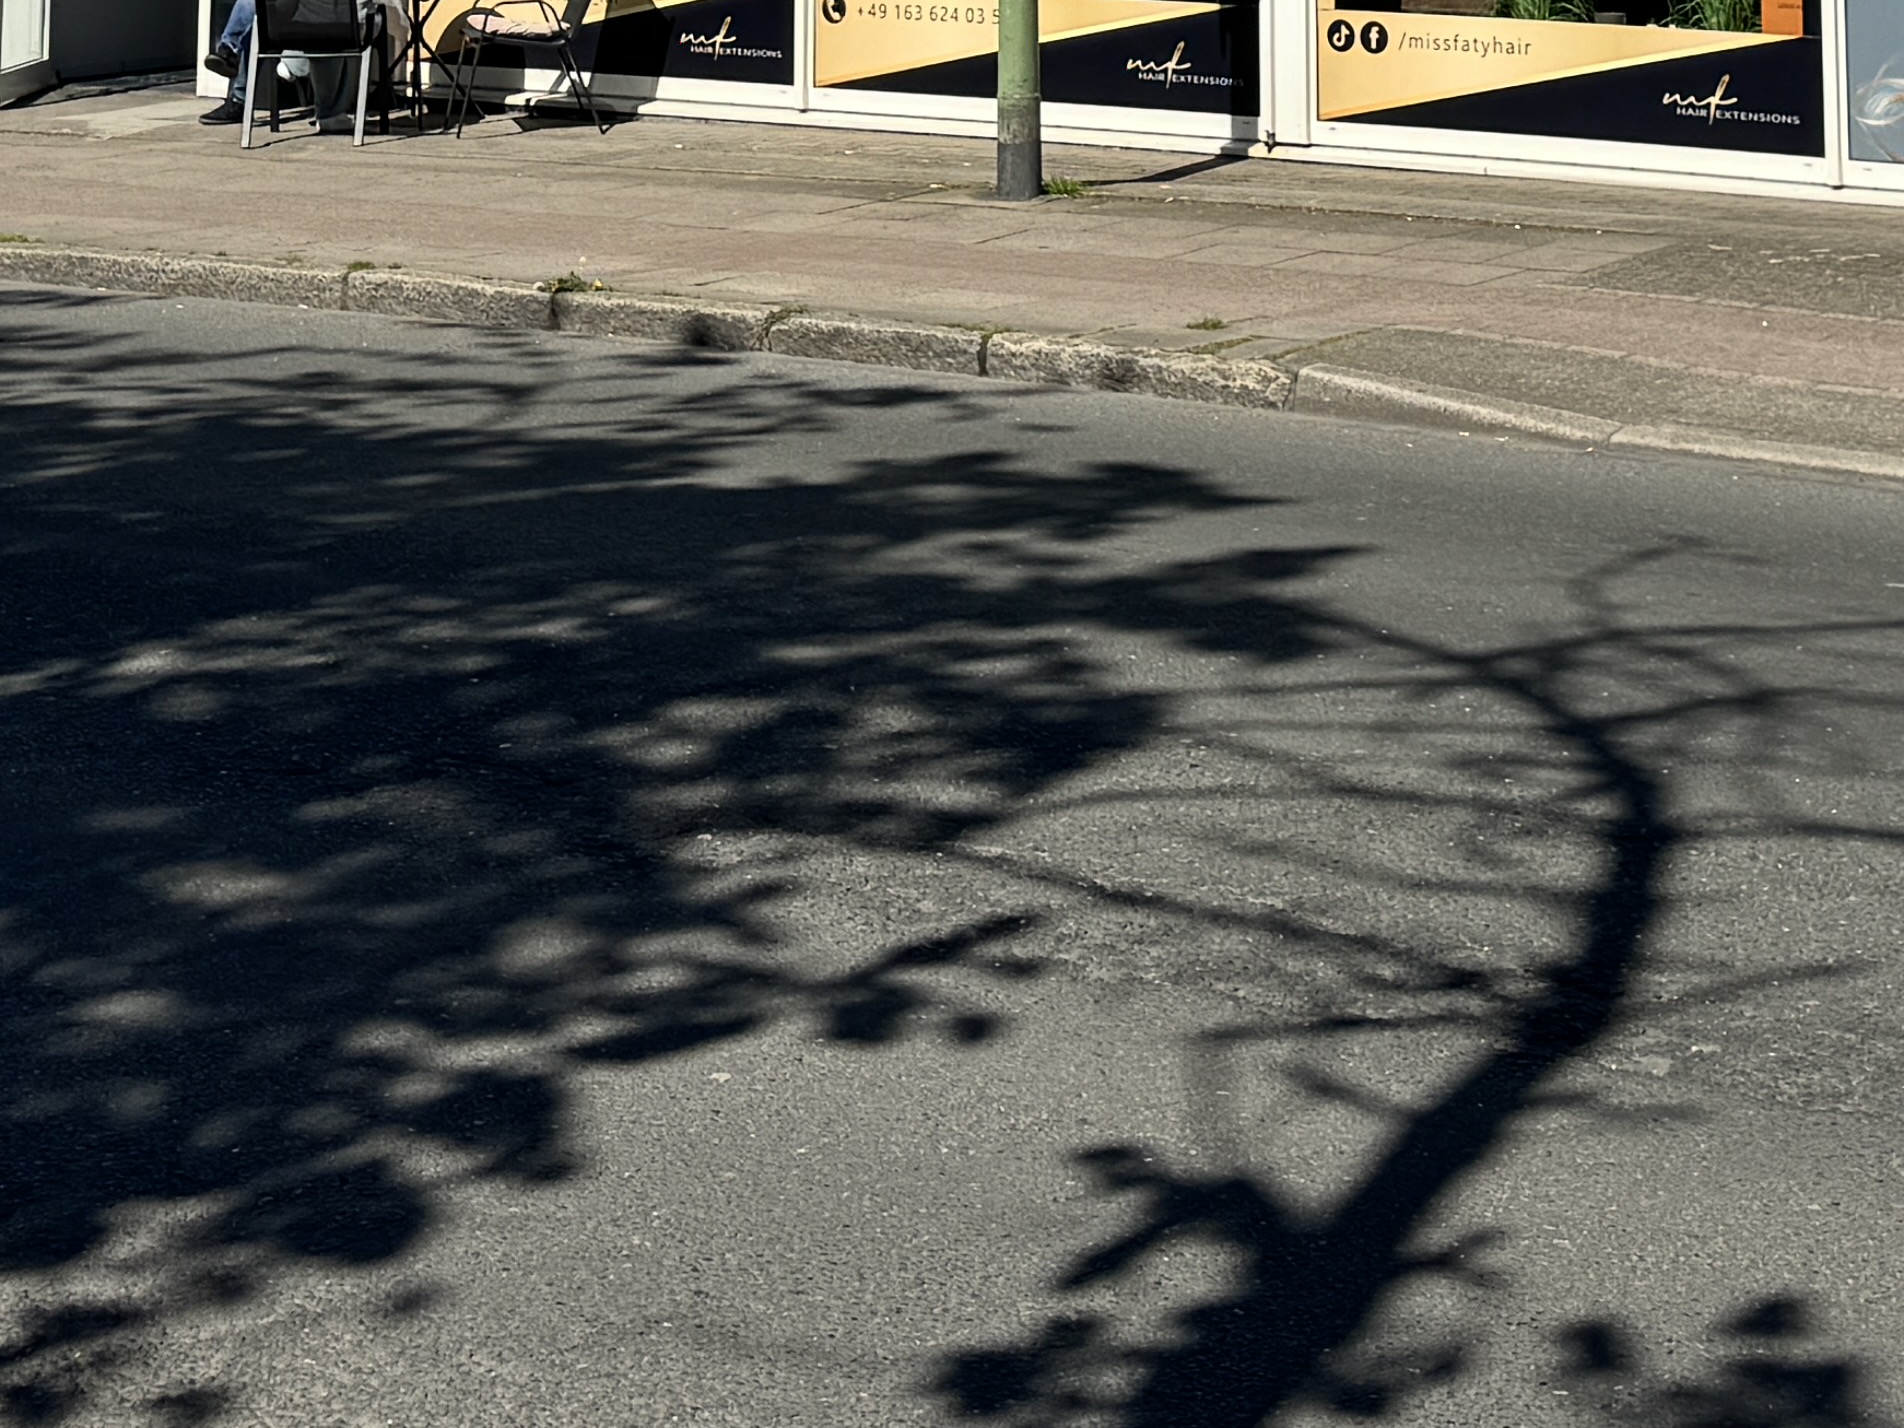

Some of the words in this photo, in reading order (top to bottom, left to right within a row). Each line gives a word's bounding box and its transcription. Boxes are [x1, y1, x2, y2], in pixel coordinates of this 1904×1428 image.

[858, 2, 888, 20] +49
[895, 4, 923, 21] 163
[929, 5, 959, 23] 624
[965, 7, 986, 24] 03
[690, 44, 714, 55] HAIR
[719, 45, 783, 59] EXTENSIONS
[1398, 30, 1533, 58] /missfatyhair
[1138, 71, 1165, 81] HAIR
[1172, 73, 1245, 88] EXTENSIONS
[1676, 105, 1708, 117] HAIR
[1715, 109, 1801, 125] EXTENSIONS
